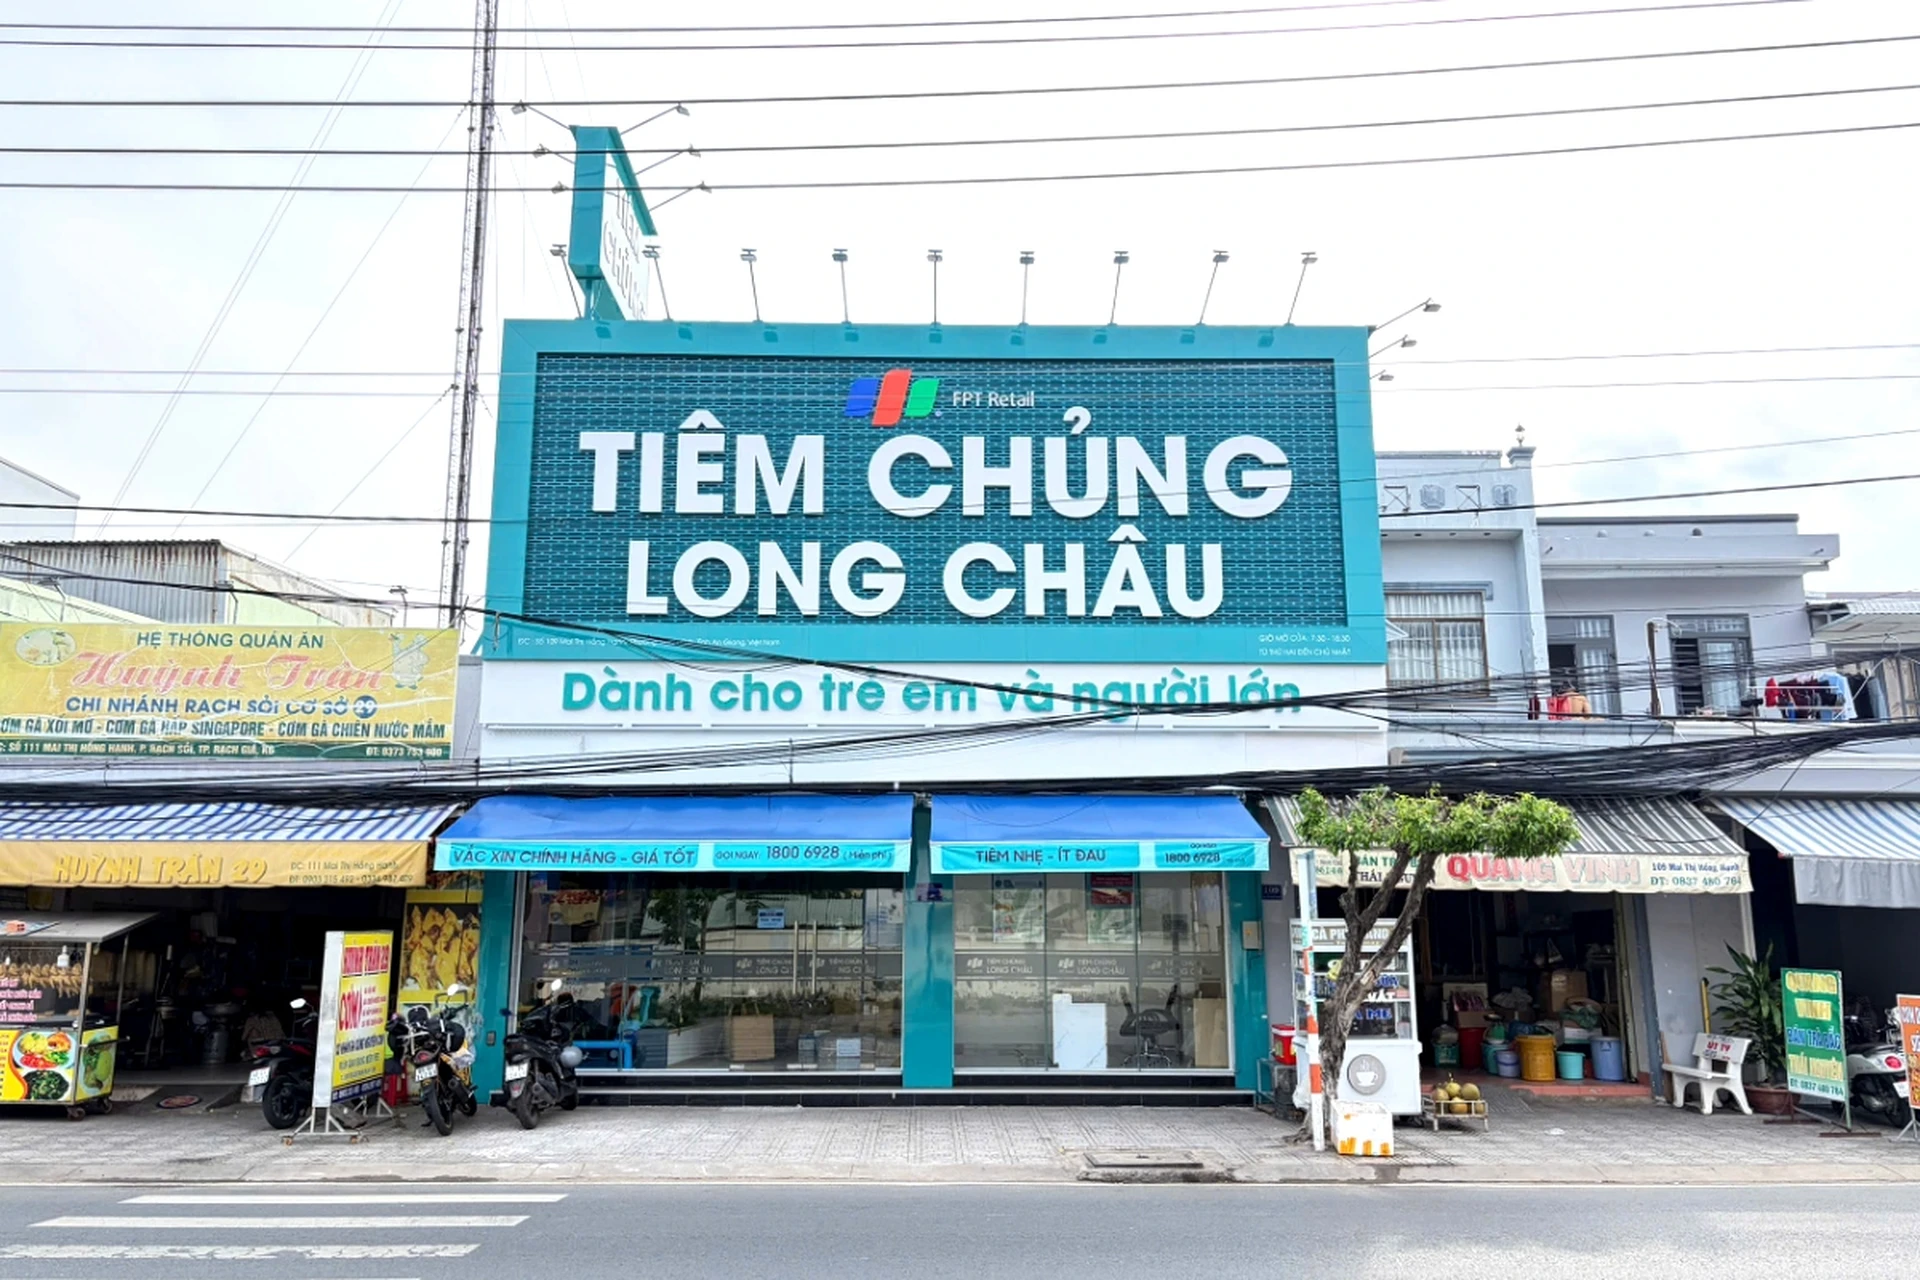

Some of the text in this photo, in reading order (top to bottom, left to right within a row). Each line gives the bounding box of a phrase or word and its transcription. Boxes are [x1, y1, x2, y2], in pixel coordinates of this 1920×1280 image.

[953, 391, 1035, 407] FPT Retail
[580, 405, 1293, 519] TIÊM CHỦNG
[626, 523, 1225, 618] LONG CHÂU
[137, 631, 162, 649] HỆ
[240, 630, 292, 648] QUÁN
[562, 664, 692, 711] Dành
[710, 672, 801, 712] cho
[902, 680, 977, 712] em
[995, 667, 1053, 712] và
[1229, 666, 1301, 714] lớn
[66, 697, 100, 712] CHI
[108, 694, 178, 713] NHÁNH
[185, 698, 240, 716] RẠCH
[191, 720, 265, 736] SINGAPORE
[278, 721, 307, 737] CƠM
[24, 743, 40, 753] 111
[453, 844, 486, 863] VẮC
[490, 850, 517, 863] XIN
[519, 847, 568, 863] CHÍNH
[631, 847, 659, 864] GIÁ
[664, 845, 694, 864] TỐT
[766, 845, 800, 860] 1800
[803, 845, 840, 860] 6928
[975, 846, 1010, 863] TIÊM
[1013, 850, 1044, 866] NHẸ
[1058, 846, 1071, 862] ÍT
[1075, 848, 1107, 862] ĐAU
[1165, 852, 1191, 863] 1800
[1193, 852, 1221, 863] 6928
[231, 857, 268, 883] 29
[307, 861, 321, 871] 111
[1446, 854, 1556, 883] QUANG
[1562, 857, 1641, 885] VINH
